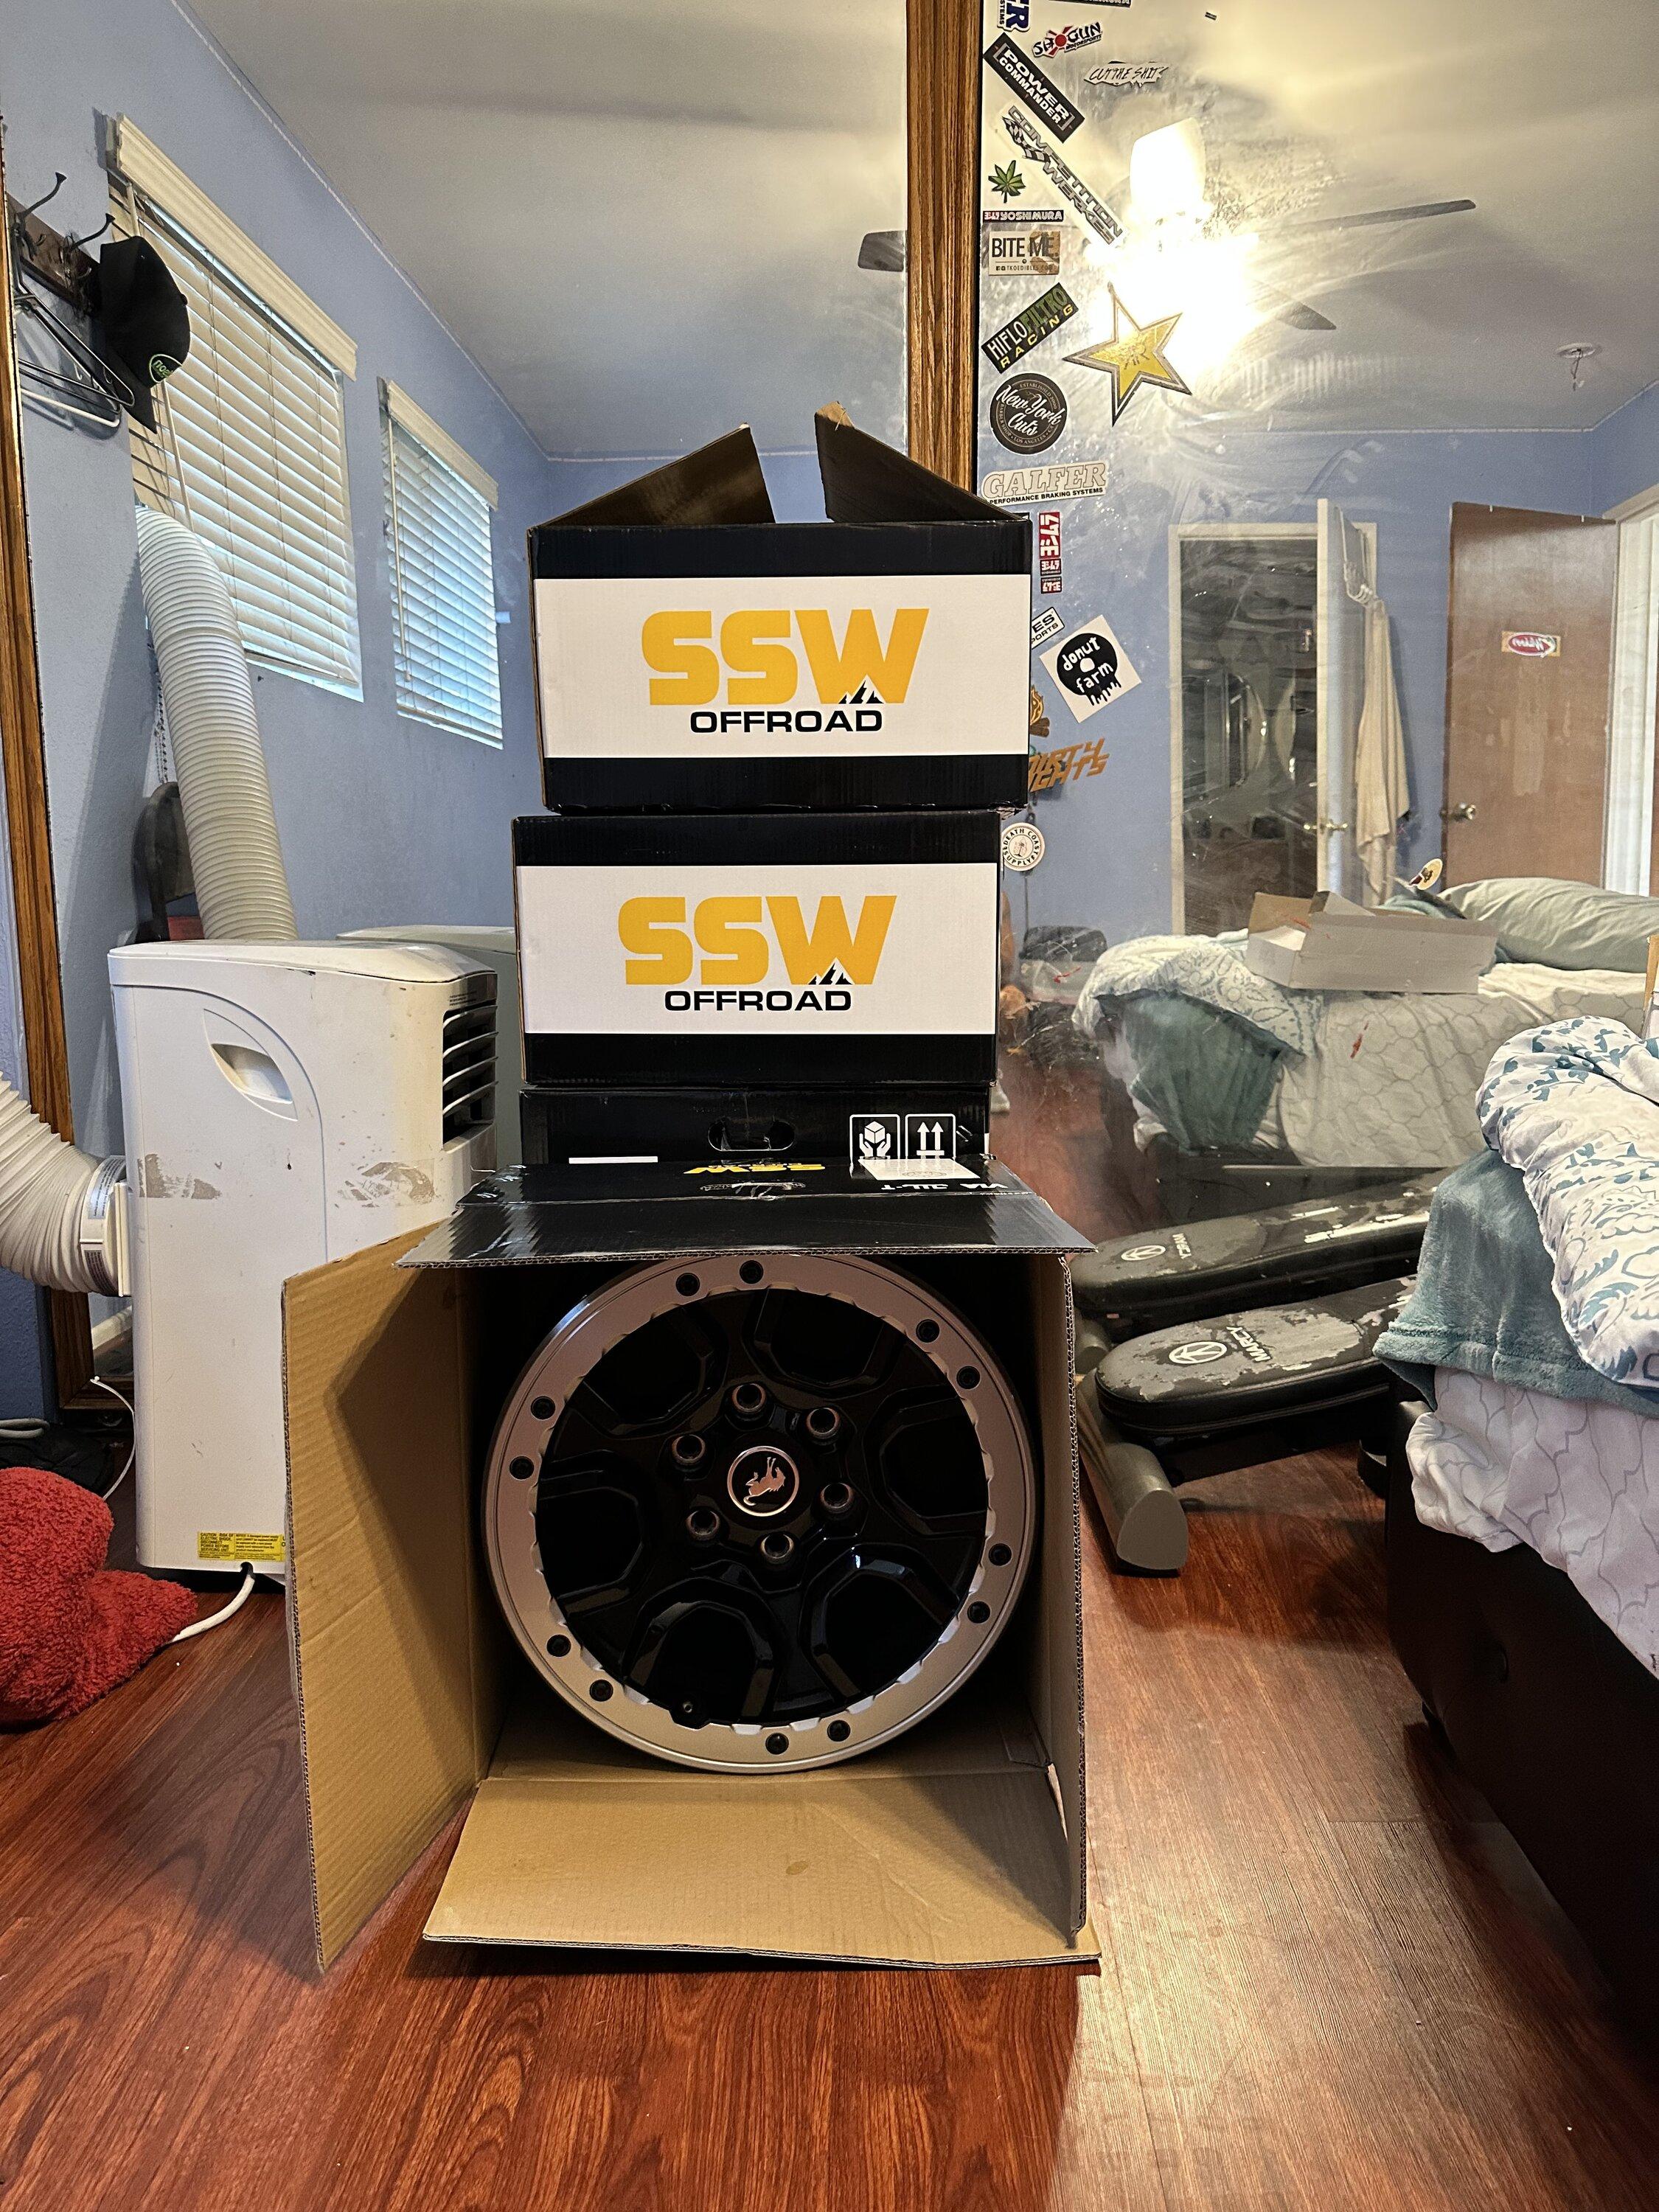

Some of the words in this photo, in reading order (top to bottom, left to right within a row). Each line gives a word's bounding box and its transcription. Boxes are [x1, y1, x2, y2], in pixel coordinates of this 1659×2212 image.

[1033, 22, 1102, 55] SHOGUN
[999, 57, 1062, 124] COMMANDER
[1004, 49, 1069, 120] POWER
[1008, 105, 1123, 237] COMPETITION
[1000, 210, 1063, 221] YOSHIMURA
[992, 237, 1025, 258] BITE
[1000, 304, 1074, 369] RACING
[995, 384, 1029, 409] New
[1025, 393, 1065, 425] York
[1007, 412, 1039, 436] Cuts
[1024, 435, 1046, 444] ANGELES
[983, 462, 1106, 498] GALFER
[990, 495, 1039, 504] PERFORMANCE
[1041, 491, 1070, 500] BRAKING
[1072, 487, 1103, 495] SYSTEMS
[1031, 622, 1059, 644] PORTS
[1032, 613, 1055, 633] ES
[641, 608, 930, 706] SSW
[1062, 636, 1101, 671] donut
[1076, 663, 1114, 693] farm
[689, 709, 883, 734] OFFROAD
[1003, 828, 1025, 846] DEATH
[1027, 830, 1040, 855] COAST
[1003, 850, 1032, 866] SUPPLY
[618, 894, 897, 986] SSW
[664, 990, 852, 1012] OFFROAD
[1226, 1326, 1271, 1363] MARCY
